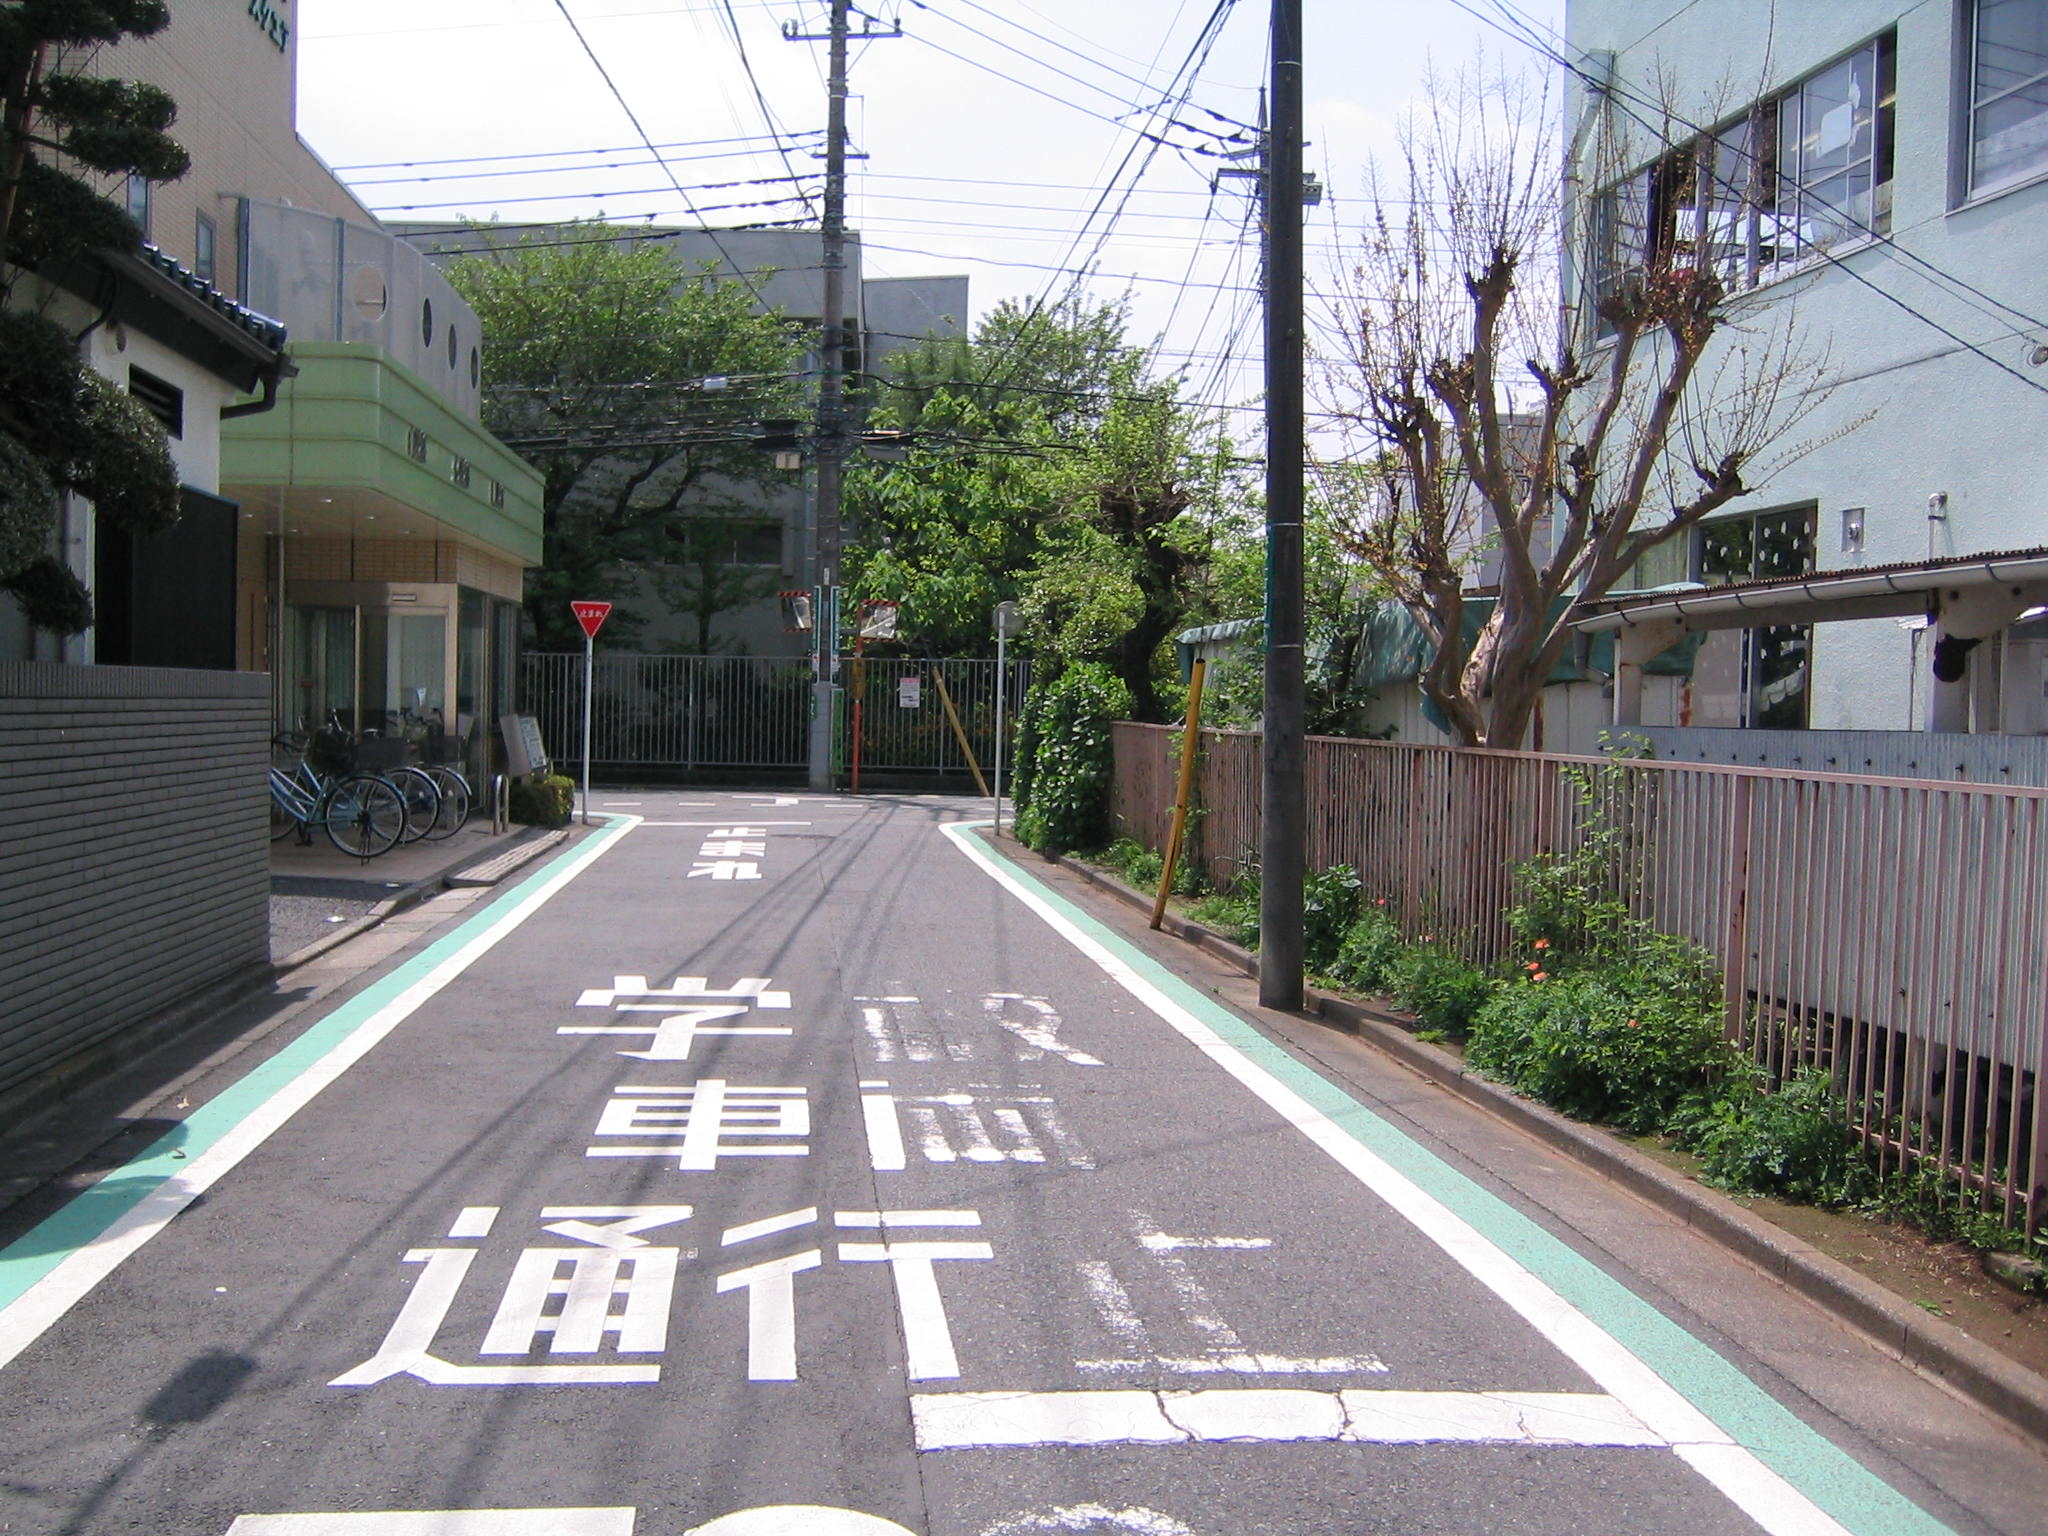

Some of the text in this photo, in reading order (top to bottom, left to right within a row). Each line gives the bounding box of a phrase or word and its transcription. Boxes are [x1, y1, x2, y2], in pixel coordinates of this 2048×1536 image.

[578, 608, 605, 618] 止まれ
[687, 827, 767, 880] 止まれ
